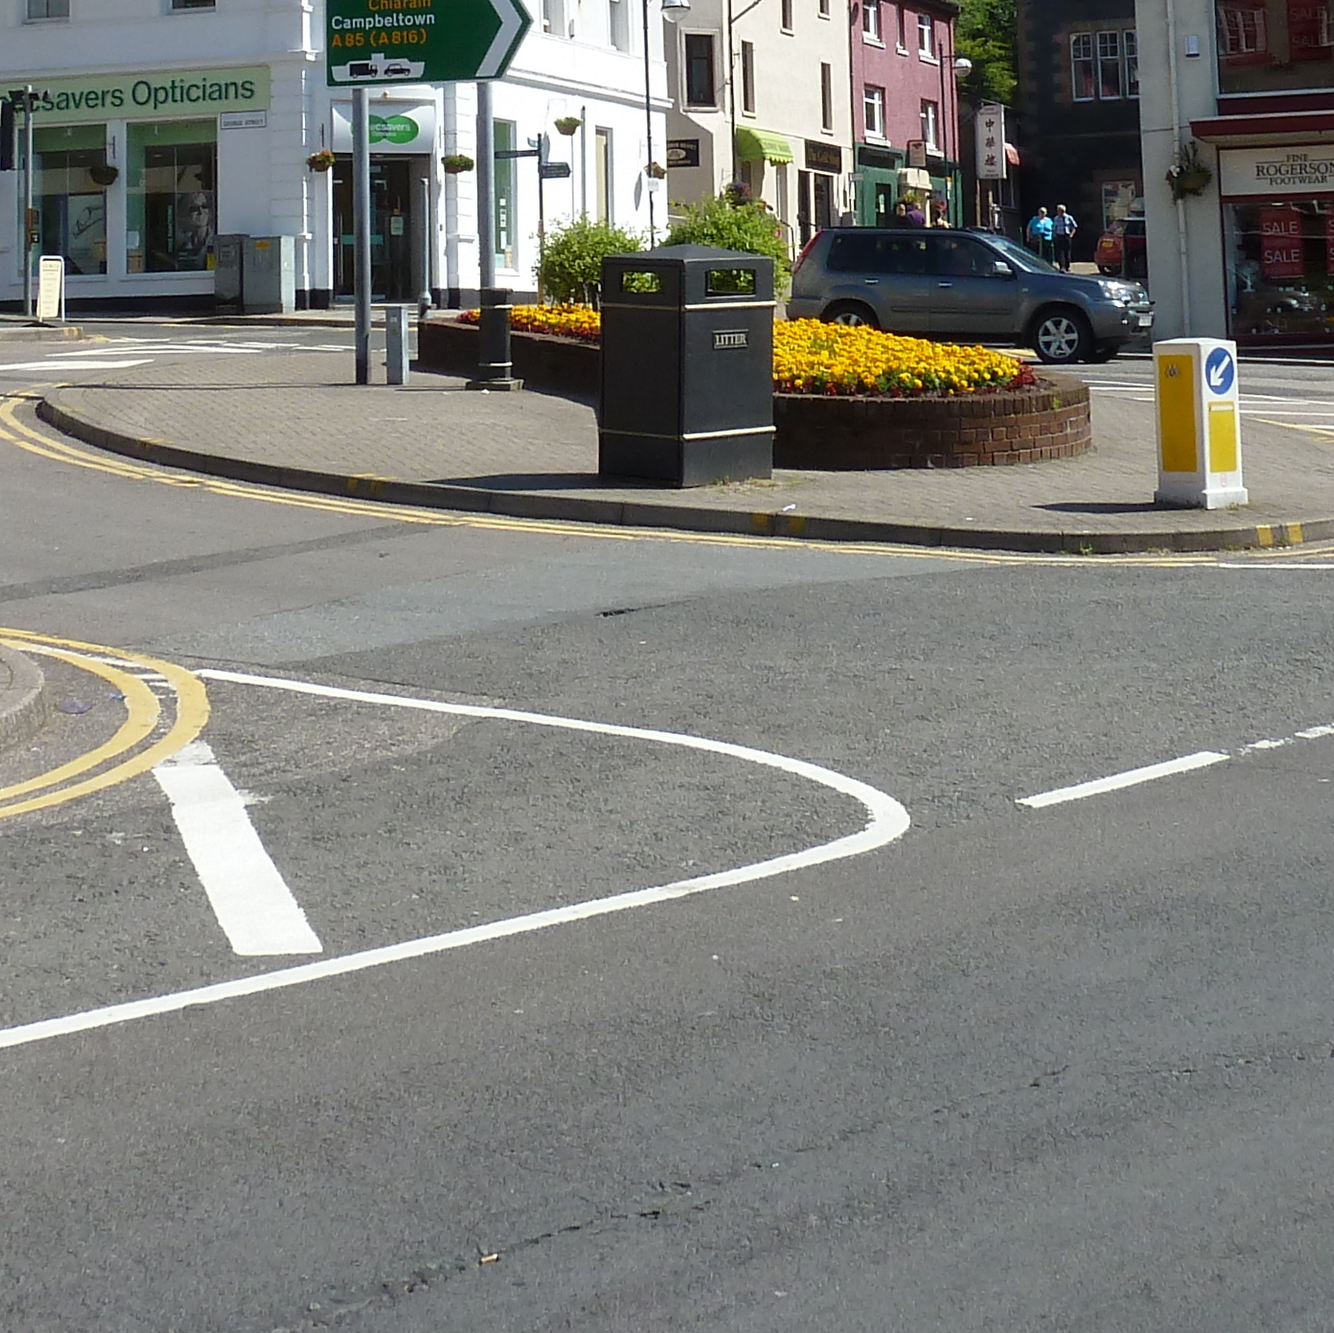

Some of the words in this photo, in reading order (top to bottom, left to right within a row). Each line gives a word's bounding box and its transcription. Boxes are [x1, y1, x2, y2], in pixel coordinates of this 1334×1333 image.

[332, 12, 435, 30] Campbeltown
[131, 78, 256, 110] Opticians
[1286, 153, 1309, 163] FINE
[1269, 174, 1328, 187] FOOTWEAR
[1262, 221, 1298, 235] SALE
[1264, 248, 1301, 264] SALE
[715, 334, 746, 345] LITTER
